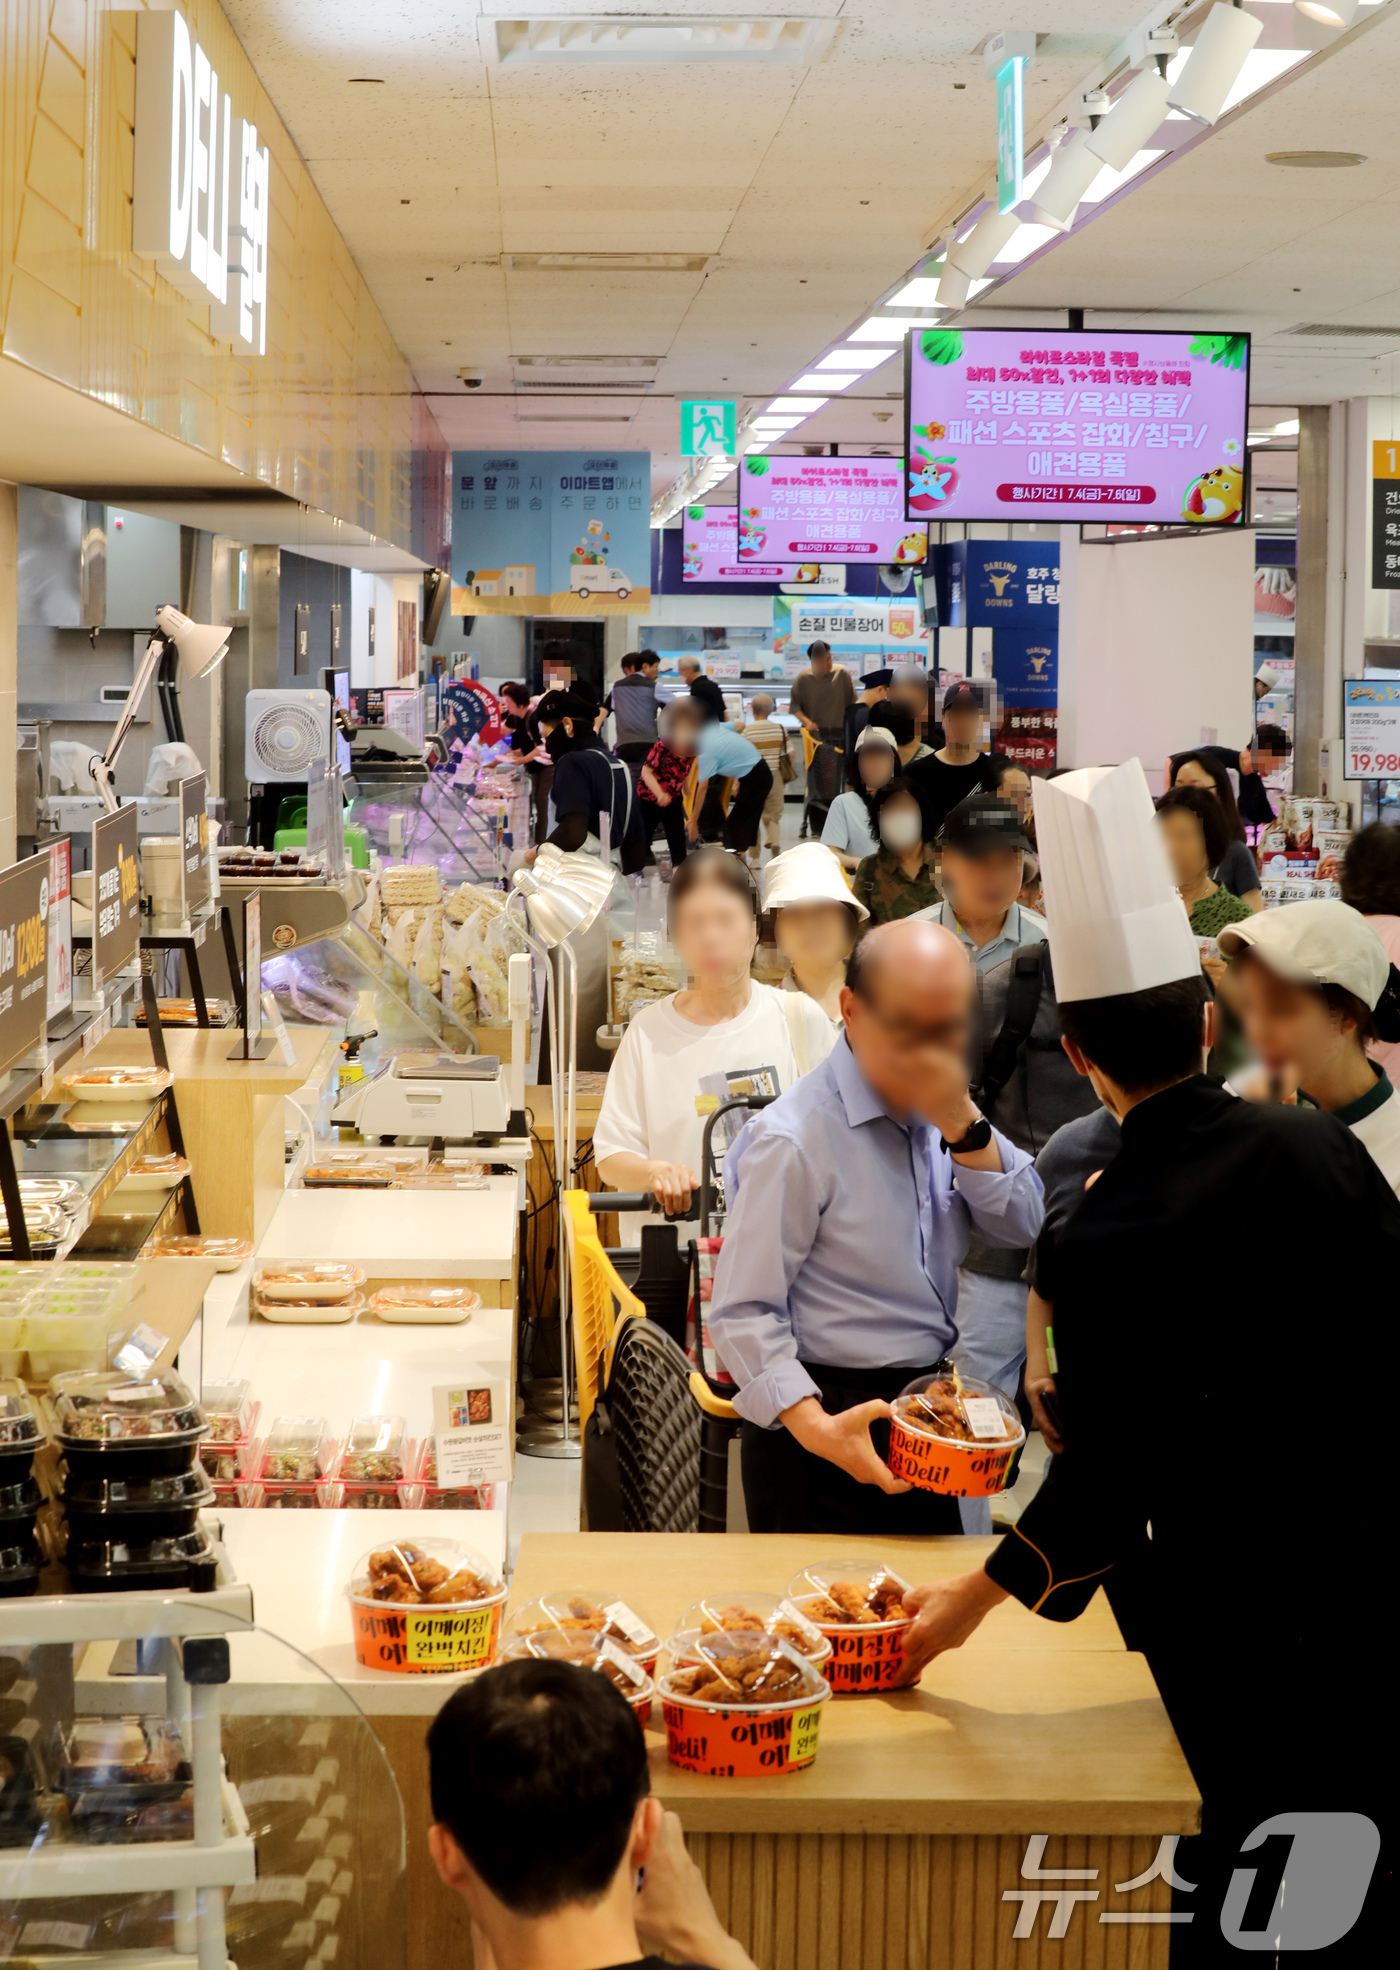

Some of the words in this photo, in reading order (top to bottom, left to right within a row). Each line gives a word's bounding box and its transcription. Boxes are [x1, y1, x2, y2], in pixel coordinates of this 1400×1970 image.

[170, 10, 230, 304] DELI
[240, 118, 268, 355] 델리
[965, 389, 1193, 418] 주방용품/욕실용품/
[947, 421, 998, 446] 패션
[1002, 421, 1077, 447] 스포츠
[1081, 421, 1209, 449] 잡화/침구/
[1028, 452, 1127, 478] 애견용품
[560, 476, 641, 490] 이마트앱에서
[761, 507, 790, 521] 패션
[792, 507, 834, 522] 스포츠
[805, 524, 861, 539] 애견용품
[983, 560, 1018, 574] DARLING
[1026, 567, 1050, 580] 호주
[985, 598, 1014, 608] DOWNS
[1026, 584, 1060, 604] 달링
[799, 617, 826, 632] 손질
[830, 617, 884, 632] 민물장어
[1011, 717, 1040, 729] 풍부한
[1005, 747, 1045, 759] 부드러운
[1351, 753, 1400, 773] 19,98
[897, 1431, 932, 1460] Deli!
[904, 1457, 949, 1485] Deli!
[415, 1613, 489, 1637] 어메이징!
